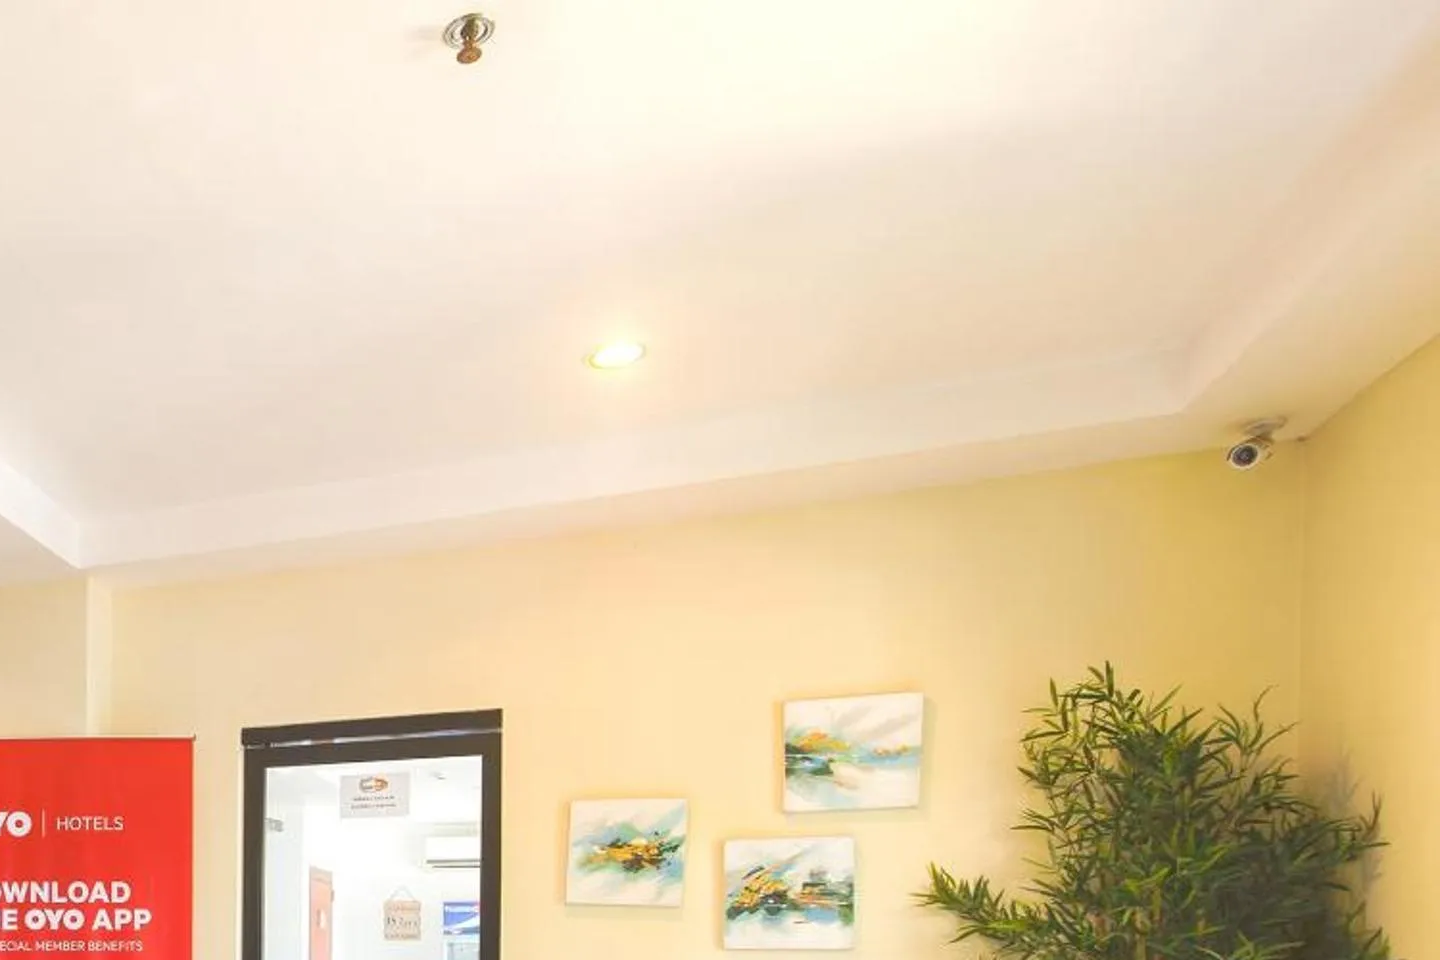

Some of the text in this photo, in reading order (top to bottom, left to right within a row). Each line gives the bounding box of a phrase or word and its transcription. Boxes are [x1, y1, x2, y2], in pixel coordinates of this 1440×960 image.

[56, 816, 124, 831] HOTELS
[25, 909, 85, 931] OYO
[92, 909, 152, 931] APP
[35, 940, 86, 952] MEMBER
[88, 940, 143, 952] BENEFITS
